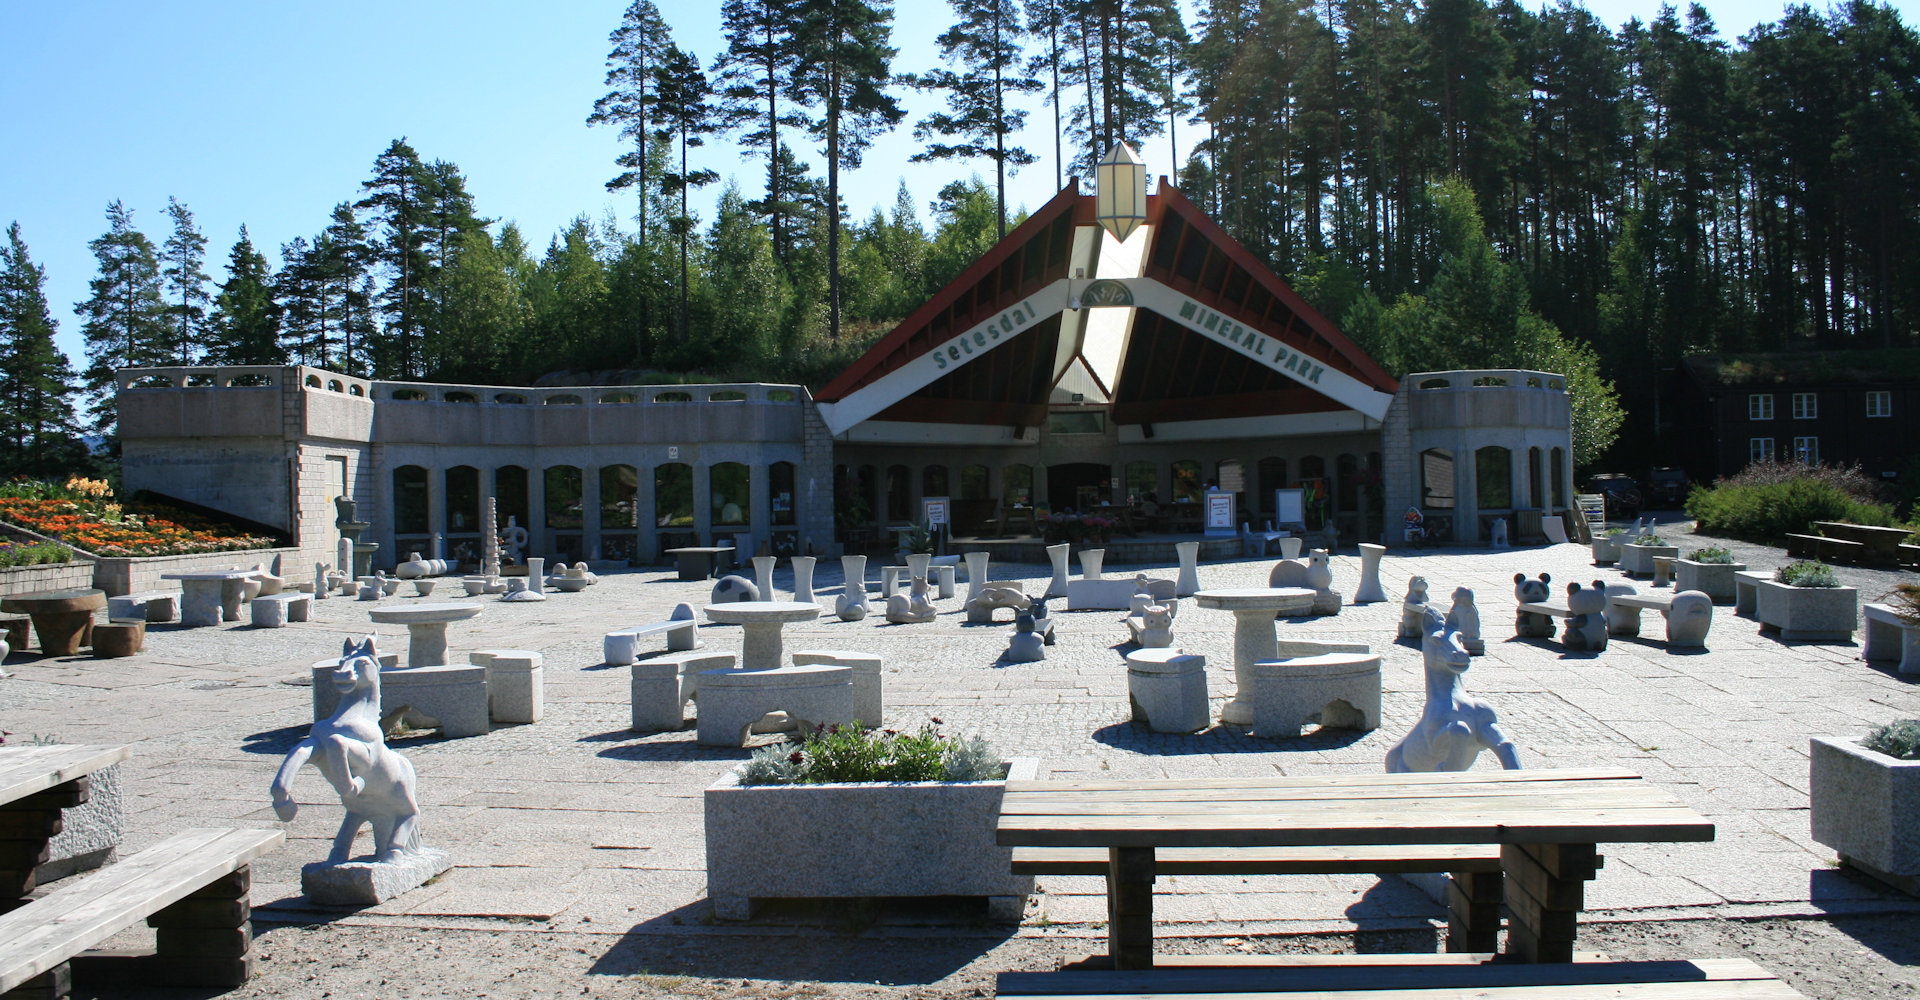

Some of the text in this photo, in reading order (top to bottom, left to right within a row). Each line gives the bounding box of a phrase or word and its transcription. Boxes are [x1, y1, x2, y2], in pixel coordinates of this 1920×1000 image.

[932, 300, 1036, 370] Setesdal
[1179, 300, 1324, 385] MINERAL PARK
